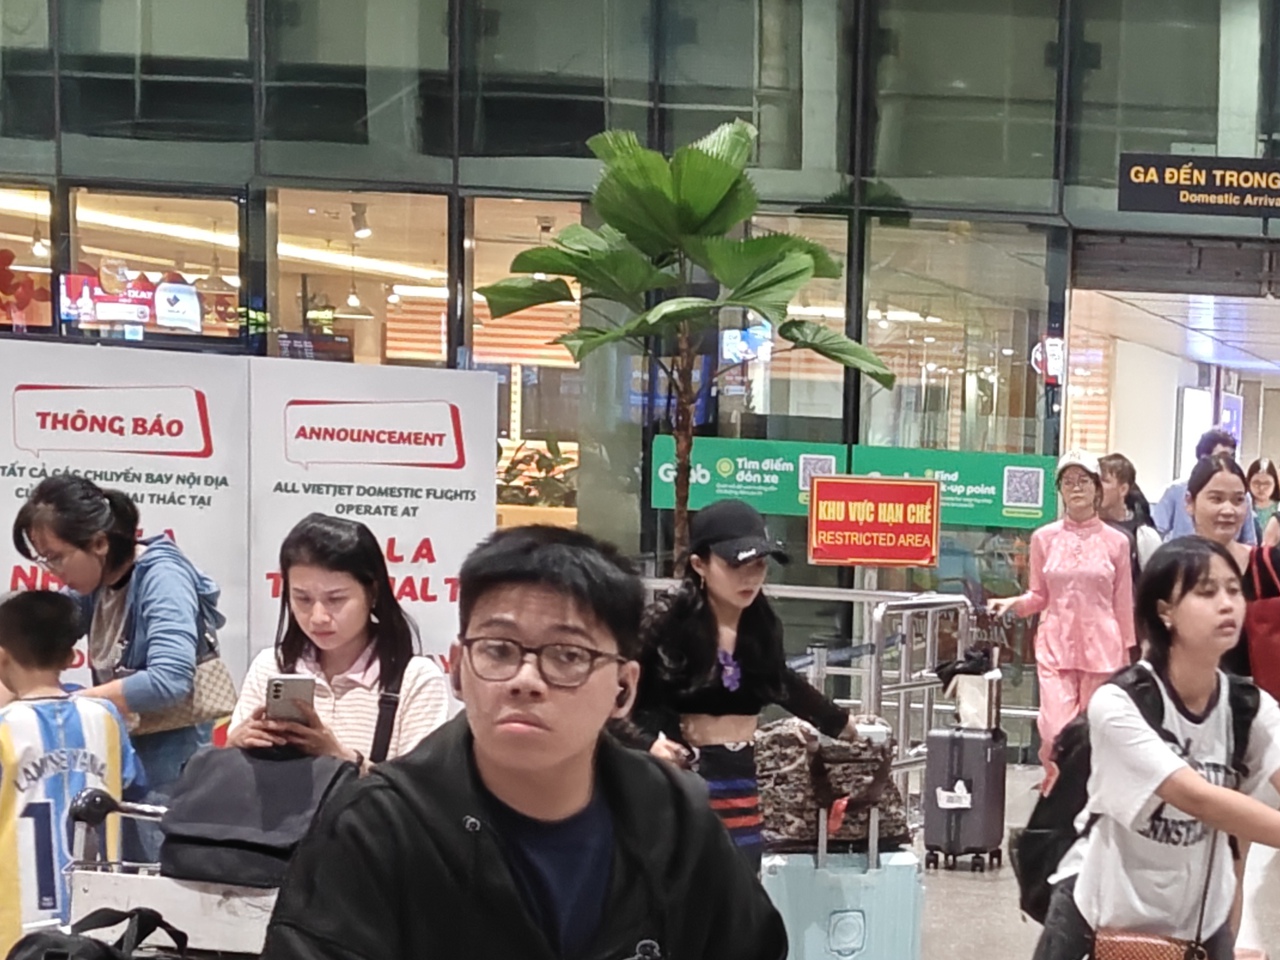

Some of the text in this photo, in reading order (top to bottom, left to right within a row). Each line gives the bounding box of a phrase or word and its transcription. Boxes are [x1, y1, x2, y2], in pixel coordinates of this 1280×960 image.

[1129, 166, 1159, 184] GA
[1164, 162, 1206, 186] ĐẾN
[1179, 189, 1240, 206] Domestic
[36, 409, 184, 437] THÔNG BÁO
[295, 425, 447, 447] ANNOUNCEMENT
[658, 462, 711, 485] Gab
[736, 457, 794, 472] Tìm điểm
[0, 461, 26, 477] TẤT
[29, 463, 48, 478] CẢ
[84, 467, 142, 484] CHUYẾN
[145, 472, 174, 485] BAY
[176, 473, 201, 488] NỘI
[203, 475, 229, 490] ĐỊA
[736, 470, 779, 484] đón xe
[273, 481, 477, 501] ALL VIETJET DOMESTIC FLIGHTS
[966, 484, 996, 496] point
[148, 492, 186, 506] THÁC
[189, 495, 212, 509] TẠI
[335, 503, 419, 517] OPERATE AT
[818, 501, 845, 521] KHU
[849, 499, 874, 525] VỰC
[878, 503, 904, 526] HẠN
[907, 498, 931, 524] CHẾ
[818, 531, 931, 547] RESTRICTED AREA
